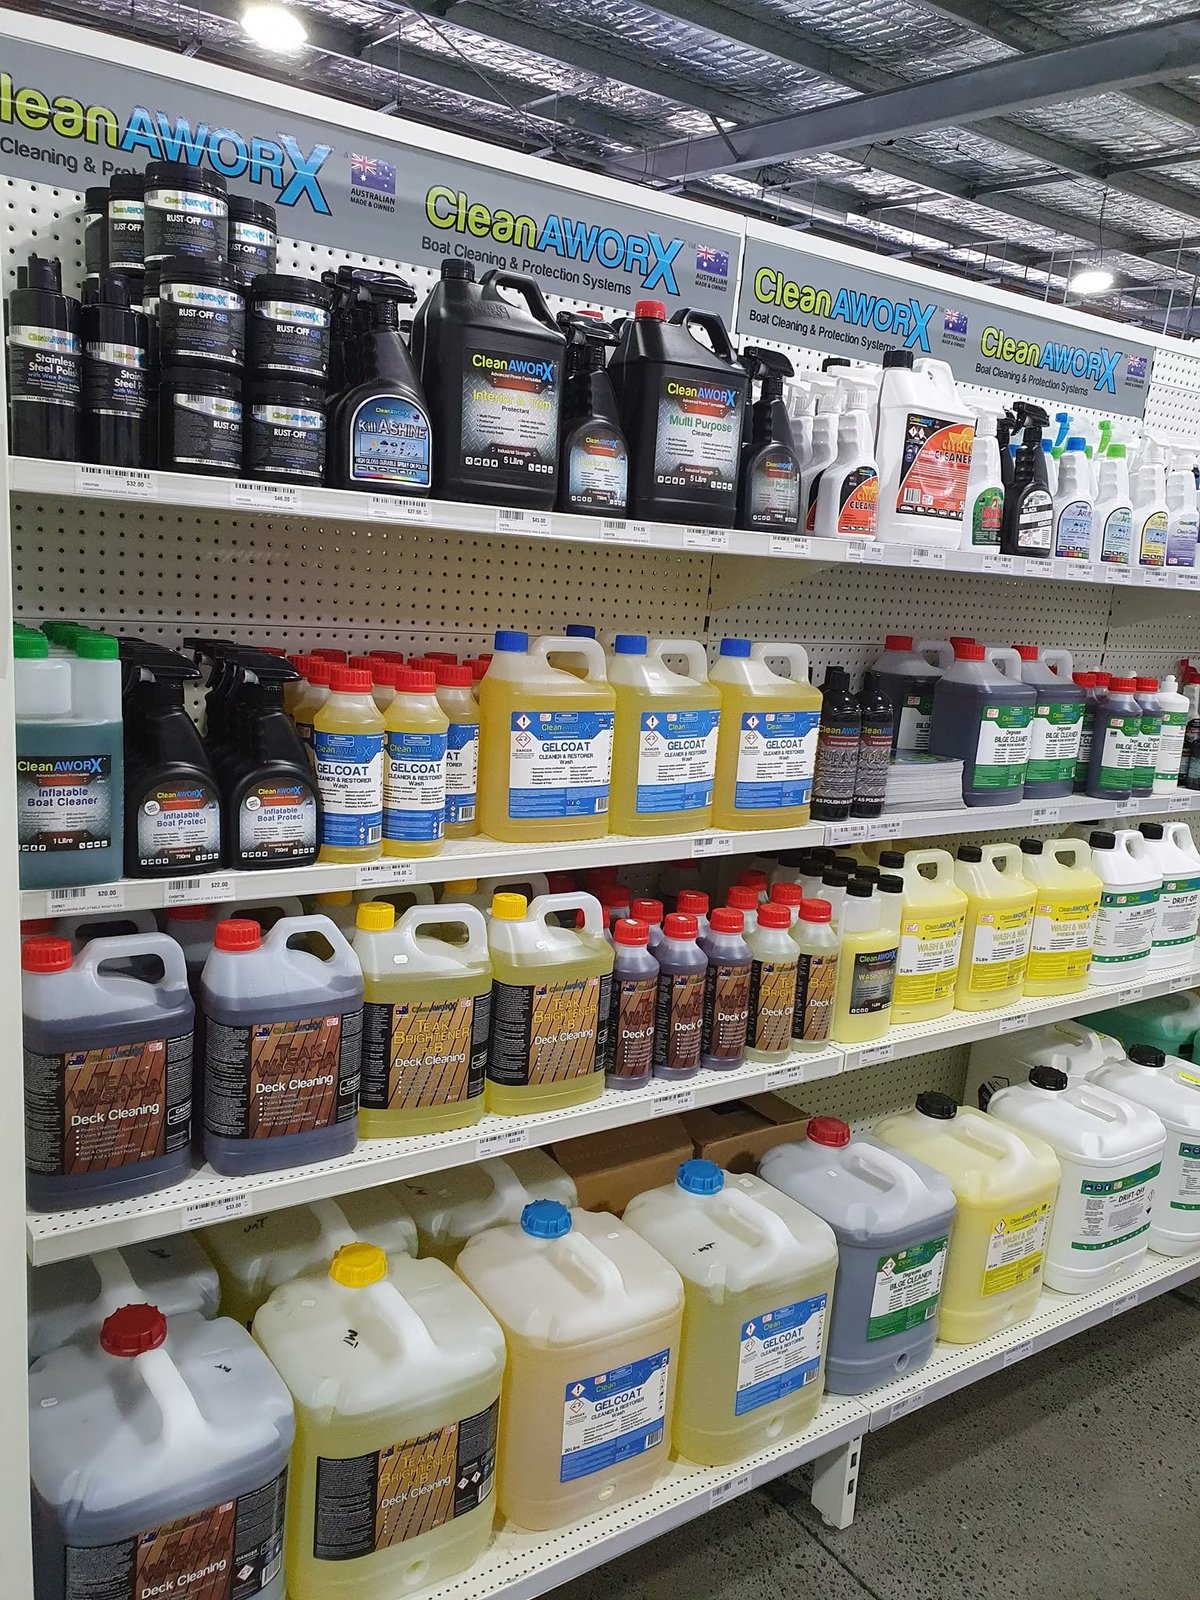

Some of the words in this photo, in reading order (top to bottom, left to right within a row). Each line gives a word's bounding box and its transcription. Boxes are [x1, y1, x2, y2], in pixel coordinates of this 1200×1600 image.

[0, 72, 335, 216] leanAWORX
[0, 137, 78, 173] Cleaning
[83, 156, 96, 174] &
[350, 187, 396, 205] AUSTRALIAN
[350, 196, 372, 208] MADE
[377, 202, 396, 213] OWNED
[166, 214, 202, 226] RUST-OFF
[201, 218, 214, 228] GEL
[425, 185, 686, 296] CleanAWORX
[421, 236, 451, 254] Boat
[454, 242, 507, 270] Cleaning
[509, 256, 519, 270] &
[521, 259, 580, 284] Protection
[582, 273, 632, 296] Systems
[696, 272, 728, 286] AUSTRALIAN
[178, 308, 215, 320] RUST-OFF
[215, 312, 229, 323] GEL
[753, 266, 938, 353] CleanAWORX
[276, 325, 310, 337] RUST-OFF
[749, 309, 770, 324] Boat
[771, 314, 808, 336] Cleaning
[809, 325, 816, 335] &
[818, 327, 859, 345] Protection
[860, 336, 896, 351] Systems
[35, 353, 76, 368] Stainless
[981, 326, 1123, 394] CleanAWORX
[28, 362, 53, 373] Steel
[472, 354, 553, 382] CleanAWORX
[114, 379, 136, 388] Steel
[975, 363, 992, 375] Boat
[992, 366, 1021, 383] Cleaning
[1028, 375, 1060, 391] Protection
[1060, 381, 1089, 396] Systems
[473, 389, 513, 405] Interior
[667, 383, 736, 407] CleanAWORX
[501, 405, 530, 414] Protectant
[358, 420, 377, 433] Kill
[378, 418, 429, 440] ASHINE
[669, 414, 693, 427] Multi
[695, 418, 732, 433] Purpose
[273, 428, 307, 439] RUST-OFF
[691, 429, 713, 438] Cleaner
[126, 480, 145, 488] $32.00
[667, 739, 706, 751] GELCOAT
[766, 739, 803, 749] GELCOAT
[1010, 735, 1028, 743] CLEANER
[541, 741, 591, 752] GELCOAT
[17, 758, 102, 773] CleanAWORX
[317, 763, 369, 776] GELCOAT
[390, 763, 441, 774] GELCOAT
[388, 773, 412, 781] CLEANER
[417, 773, 442, 781] RESTORER
[38, 787, 89, 798] Inflatable
[156, 789, 203, 799] CleanAWORX
[257, 785, 301, 795] CleanAWORX
[27, 798, 54, 807] Boat
[57, 797, 98, 807] Cleaner
[163, 811, 200, 819] Inflatable
[257, 814, 276, 822] Boat
[278, 813, 304, 821] Protect
[263, 807, 298, 815] Inflatable
[178, 817, 207, 826] Protect
[211, 881, 229, 889] $22.00
[97, 889, 117, 897] $20.00
[1171, 894, 1198, 905] DRIFT-OFF
[1050, 922, 1072, 932] WASH
[992, 932, 1013, 942] WASH
[917, 943, 939, 953] WASH
[552, 998, 579, 1011] TEAK
[810, 999, 829, 1008] Deck
[533, 1004, 597, 1024] BRIGHTENER
[718, 1012, 740, 1021] Deck
[761, 1007, 784, 1017] Deck
[416, 1019, 450, 1033] TEAK
[675, 1022, 696, 1031] Deck
[393, 1026, 470, 1045] BRIGHTENER
[534, 1035, 558, 1045] Deck
[560, 1028, 594, 1042] Cleaning
[622, 1029, 645, 1039] Deck
[275, 1043, 323, 1063] TEAK
[255, 1058, 306, 1077] WASH
[395, 1058, 422, 1068] Deck
[425, 1053, 466, 1066] Cleaning
[91, 1069, 145, 1091] TEAK
[255, 1083, 286, 1094] Deck
[289, 1074, 334, 1090] Cleaning
[71, 1112, 105, 1127] Deck
[108, 1103, 160, 1121] Cleaning
[1118, 1186, 1146, 1203] DRIFT-OFF
[889, 1280, 907, 1291] BILGE
[906, 1269, 933, 1285] CLEANER
[762, 1327, 803, 1350] GELCOAT
[760, 1346, 781, 1357] CLEANER
[783, 1336, 805, 1349] RESTORER
[594, 1387, 643, 1413] GELCOAT
[591, 1407, 615, 1420] CLEANER
[619, 1396, 645, 1411] RESTORER
[611, 1410, 626, 1419] Wash
[401, 1452, 436, 1469] TEAK
[378, 1450, 456, 1487] BRIGHTENER
[381, 1492, 408, 1509] Deck
[410, 1475, 451, 1498] Cleaning
[140, 1580, 175, 1600] Deck
[176, 1559, 227, 1587] Cleaning
